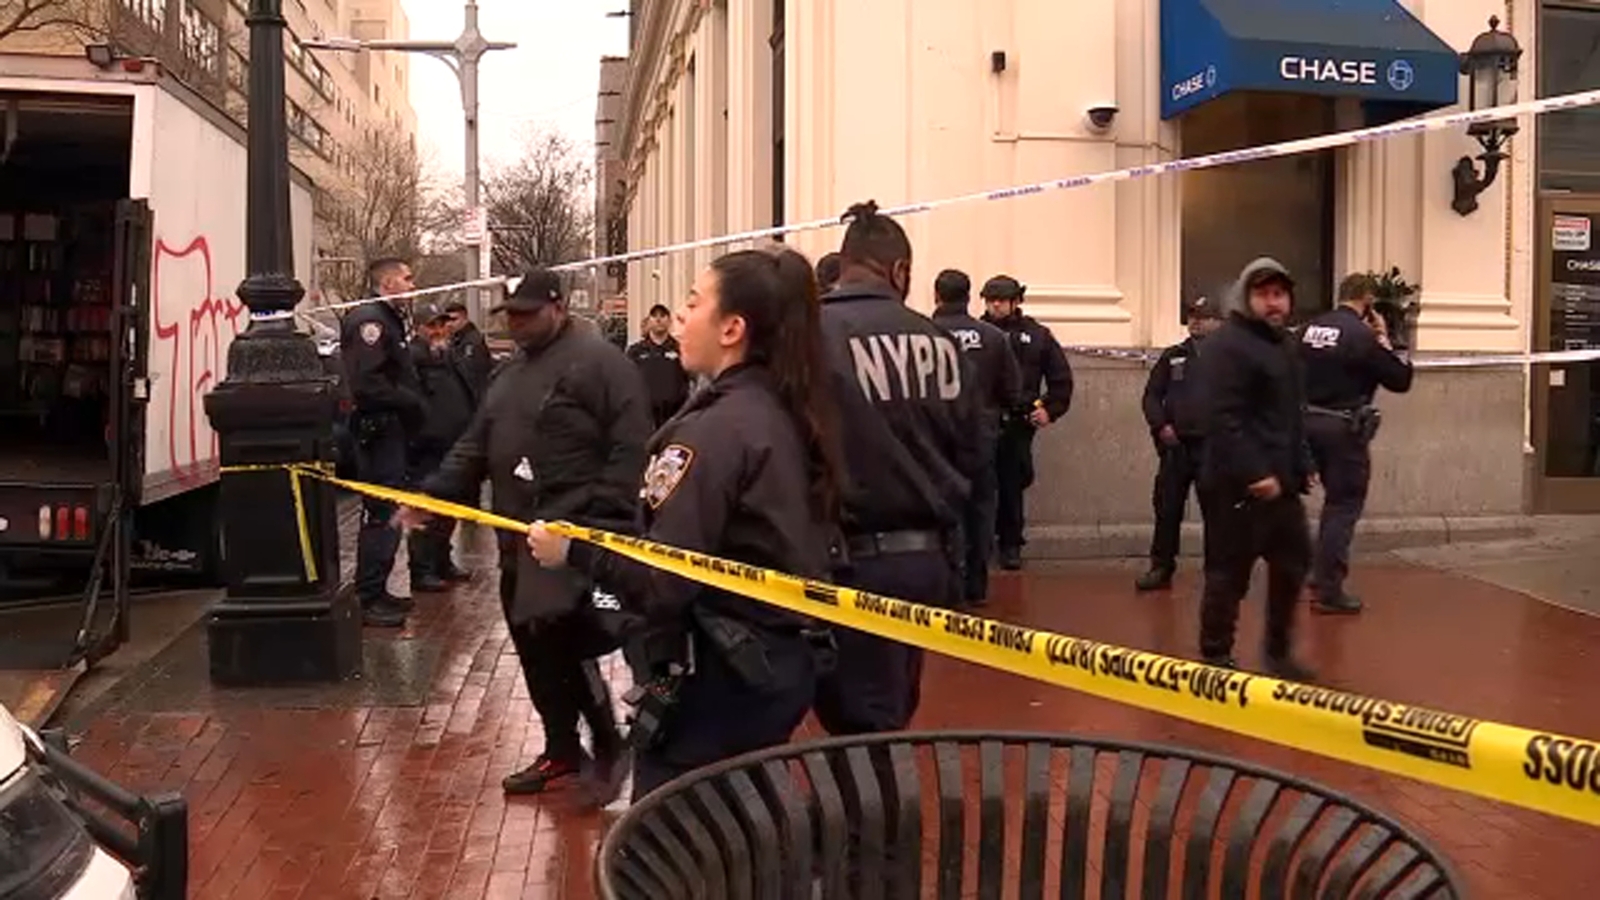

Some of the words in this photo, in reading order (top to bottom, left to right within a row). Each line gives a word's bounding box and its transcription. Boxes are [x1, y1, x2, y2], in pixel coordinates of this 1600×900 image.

[1280, 56, 1376, 84] CHASE
[1172, 71, 1205, 101] CHASE
[849, 334, 961, 403] NYPD
